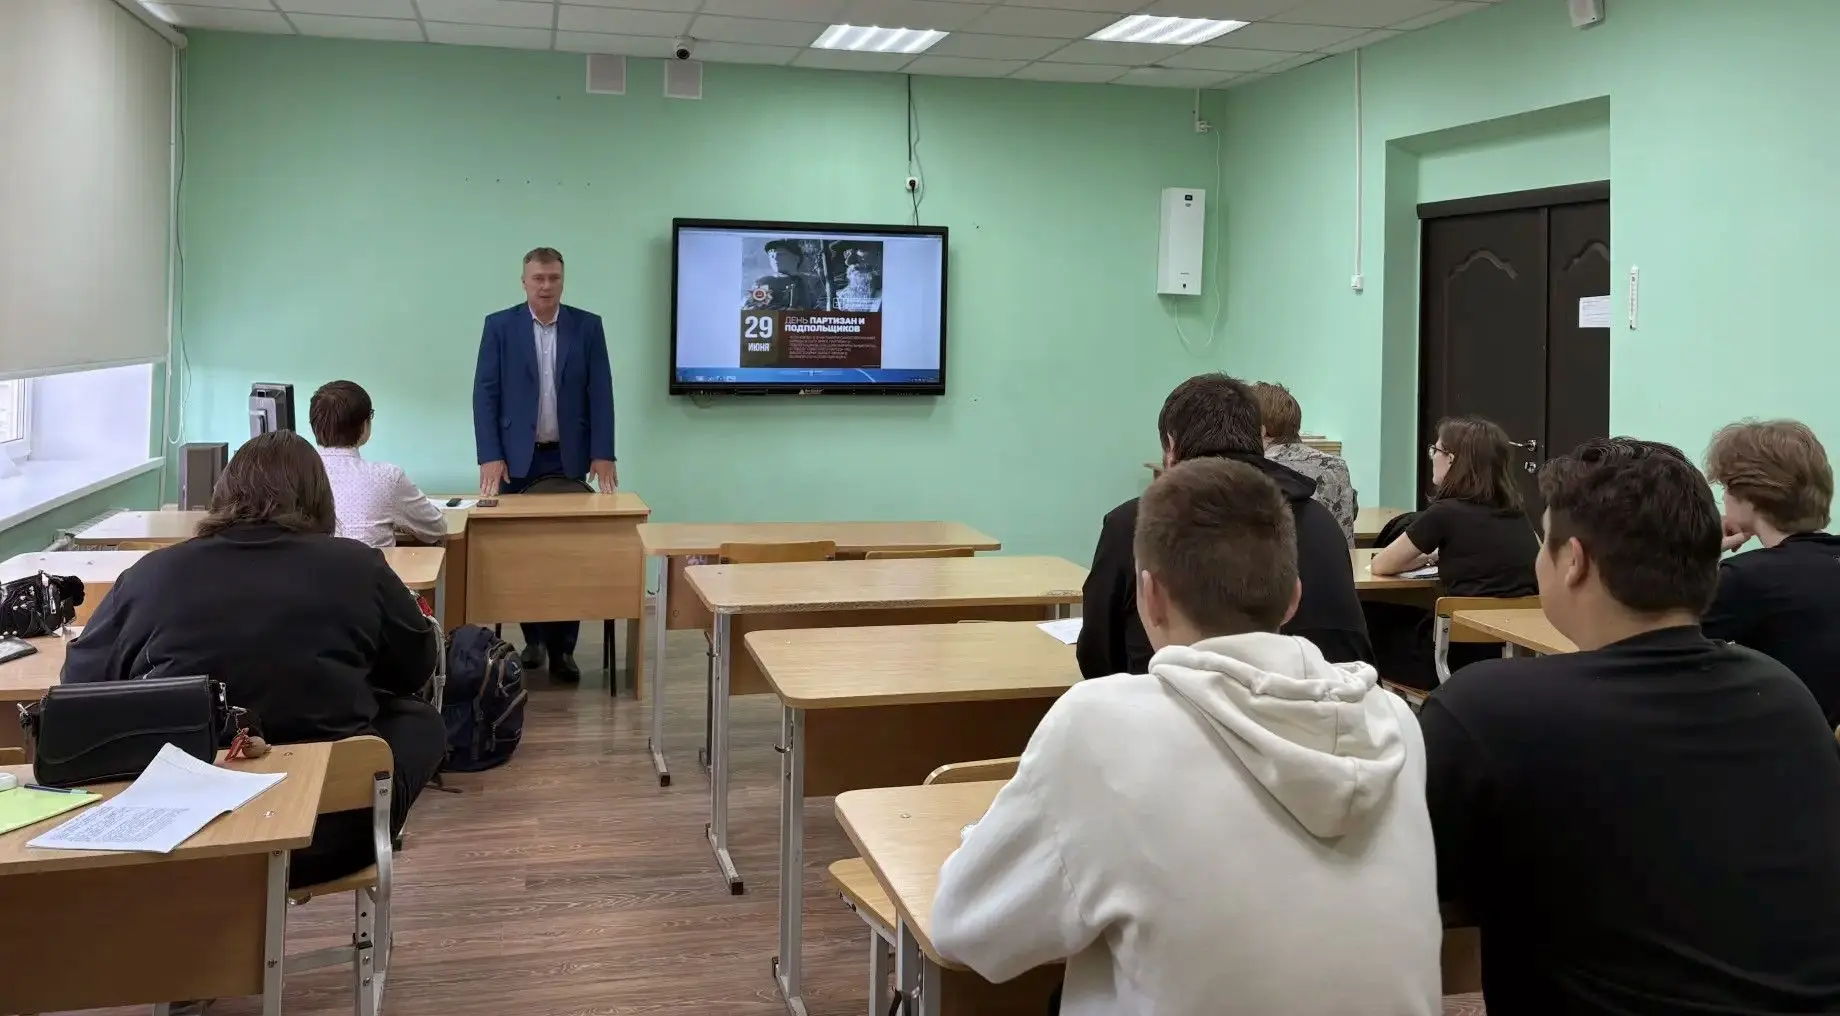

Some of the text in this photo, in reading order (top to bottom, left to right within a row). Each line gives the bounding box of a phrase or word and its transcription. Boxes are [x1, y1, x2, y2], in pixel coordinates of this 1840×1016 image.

[785, 316, 808, 324] ДЕНЬ
[744, 315, 773, 339] 29
[784, 324, 861, 332] ПОДПОЛЬЩИКОВ
[748, 342, 770, 352] ИЮНЯ
